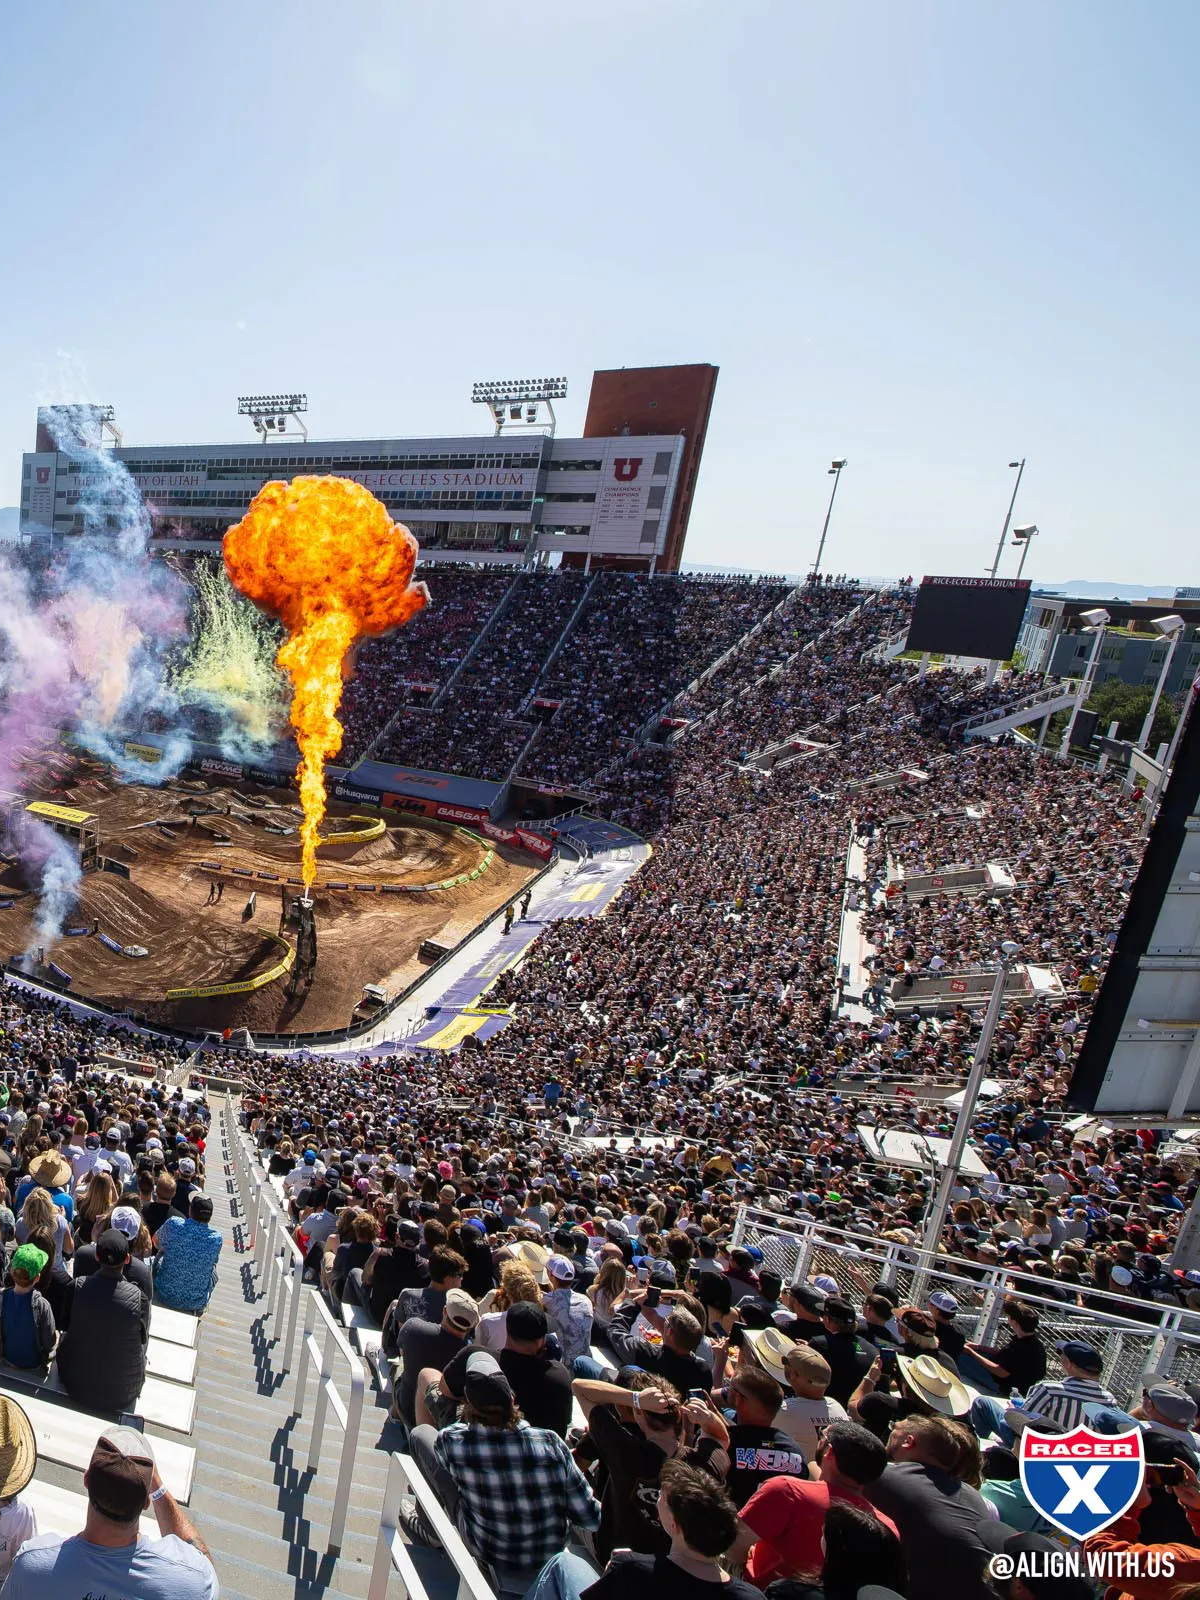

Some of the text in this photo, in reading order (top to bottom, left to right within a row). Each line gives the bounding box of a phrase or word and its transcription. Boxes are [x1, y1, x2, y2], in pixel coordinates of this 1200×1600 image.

[152, 476, 168, 486] OF
[169, 476, 199, 486] UTAH
[442, 473, 524, 486] STADIUM
[932, 577, 1017, 588] RICE-ECCLES STADIUM
[343, 788, 380, 802] Husqvarna
[437, 807, 490, 821] GASGAS
[735, 1447, 803, 1474] WEBB
